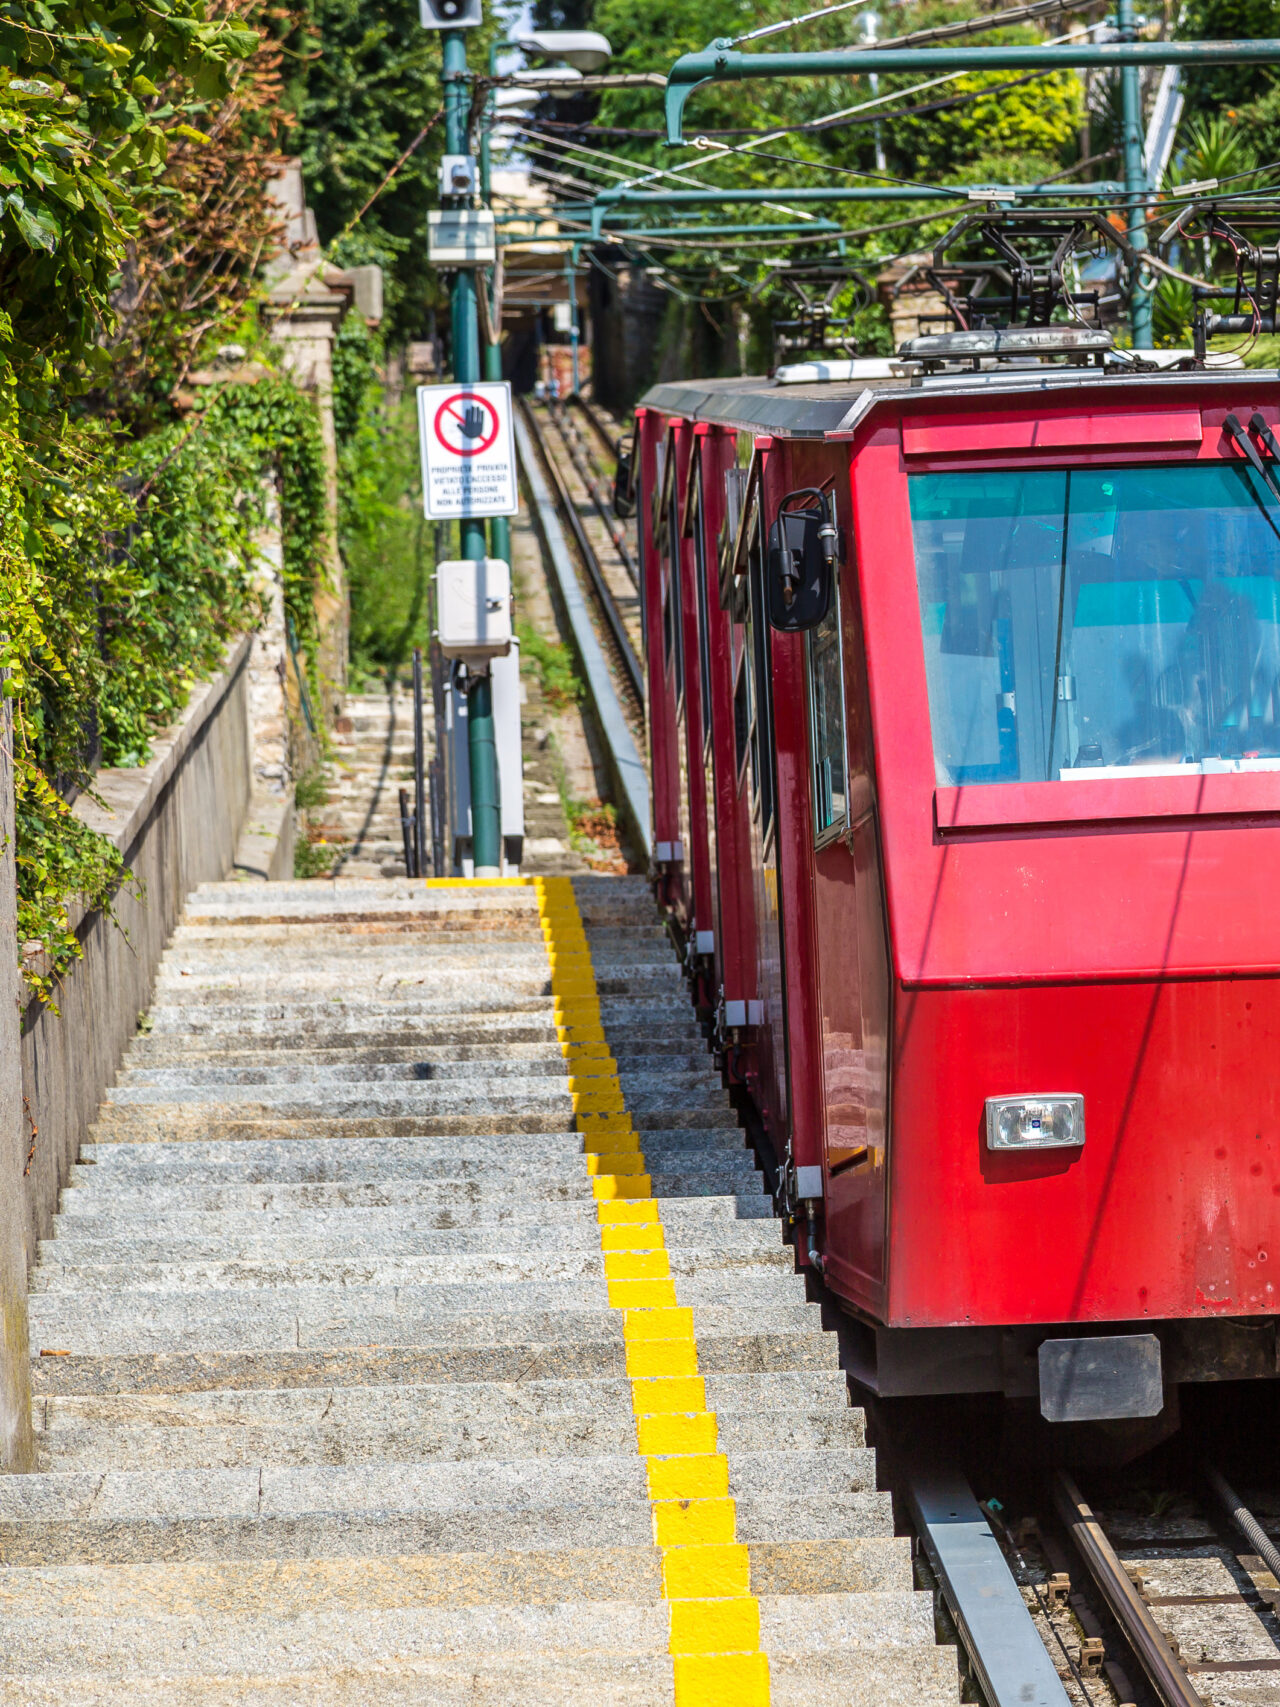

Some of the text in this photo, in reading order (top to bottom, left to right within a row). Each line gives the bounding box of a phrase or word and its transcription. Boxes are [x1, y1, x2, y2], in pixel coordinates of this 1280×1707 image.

[434, 476, 464, 485] VIETATO
[443, 486, 498, 495] ALLE PERSONE
[456, 496, 505, 506] AUTORIZZATE
